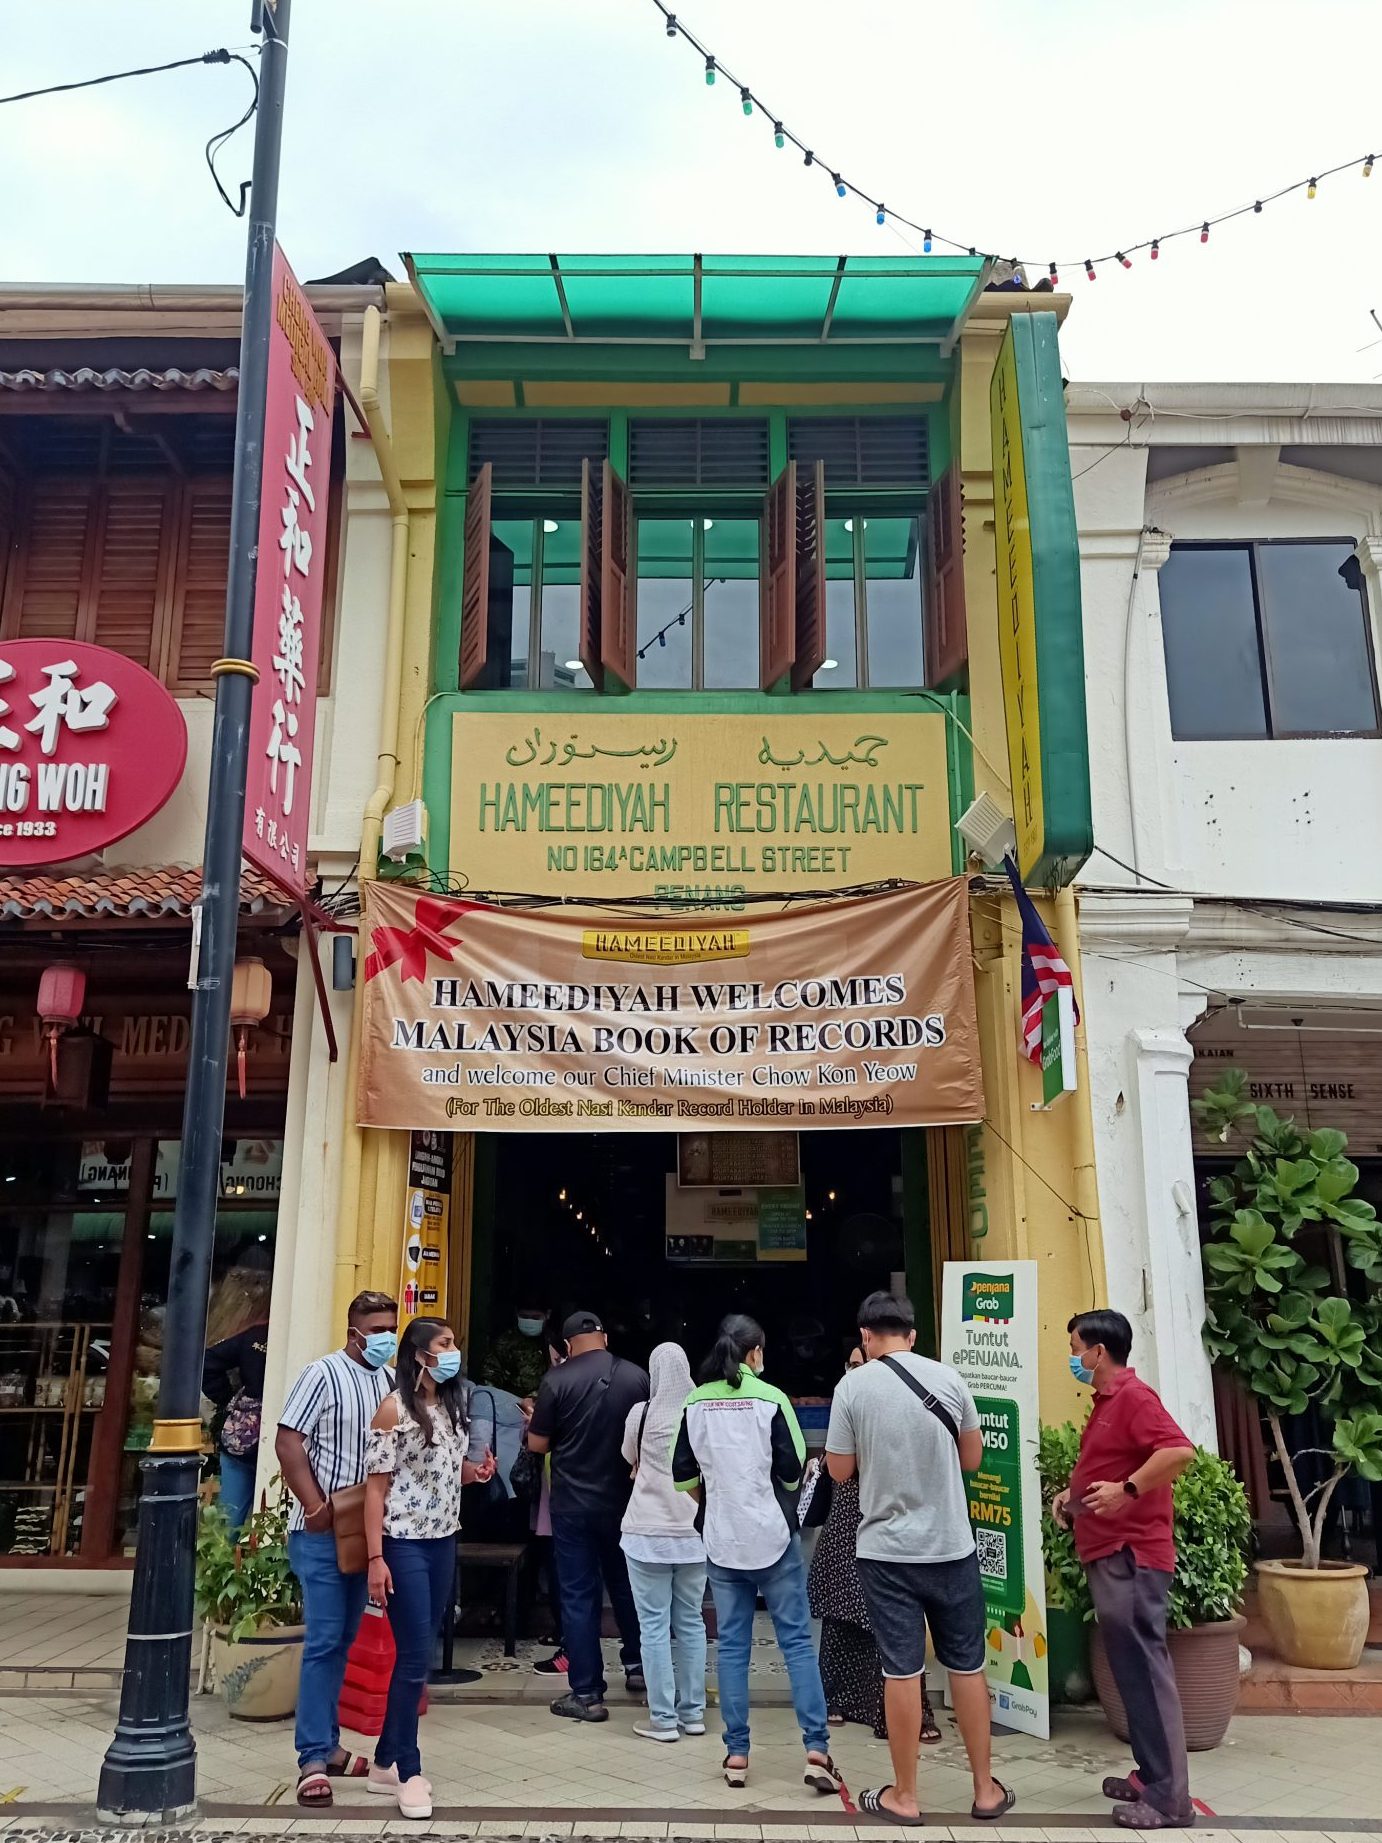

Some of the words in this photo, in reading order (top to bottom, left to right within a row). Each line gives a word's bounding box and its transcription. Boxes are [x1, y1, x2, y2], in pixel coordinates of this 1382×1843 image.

[999, 367, 1033, 829] HAMEEDIYAH
[37, 763, 111, 813] WOH
[479, 783, 670, 832] HAMEEDIYAH
[714, 783, 925, 833] RESTAURANT
[15, 821, 57, 837] 1933
[548, 845, 578, 872] NO
[629, 845, 756, 873] CAMPBELL
[761, 845, 852, 873] STREET
[654, 884, 746, 912] PENANG
[595, 933, 736, 952] HAMEEDIYAH
[432, 978, 683, 1013] HAMEEDIYAH
[689, 974, 905, 1012] WELCOMES
[392, 1018, 585, 1053] MALAYSIA
[591, 1025, 701, 1055] BOOK
[708, 1024, 759, 1054] OF
[766, 1015, 945, 1053] RECORDS
[423, 1064, 460, 1085] and
[468, 1065, 556, 1086] welcome
[563, 1069, 596, 1085] our
[604, 1066, 657, 1086] Chief
[663, 1068, 744, 1087] Minister
[752, 1066, 811, 1086] Chow
[818, 1065, 857, 1085] Kon
[863, 1062, 917, 1082] Yeow
[1250, 1083, 1294, 1099] SIXTH
[1310, 1083, 1356, 1099] SENSE
[445, 1097, 479, 1118] (For
[483, 1098, 516, 1116] The
[519, 1098, 573, 1117] Oldest
[577, 1098, 613, 1117] Nasi
[617, 1099, 674, 1117] Kandar
[678, 1099, 734, 1117] Record
[738, 1098, 794, 1116] Holder
[799, 1098, 815, 1115] In
[819, 1094, 894, 1119] Malaysia)
[977, 1282, 1010, 1295] penjana
[975, 1297, 999, 1310] Grab
[965, 1329, 1009, 1347] Tuntut
[952, 1349, 1023, 1369] ePENJANA.
[958, 1371, 981, 1379] apatkan
[967, 1381, 980, 1389] Grab
[980, 1382, 1008, 1391] PERCUMA!
[979, 1411, 1009, 1429] ntut
[981, 1430, 1008, 1450] M50
[970, 1500, 1012, 1526] RM75
[1011, 1700, 1038, 1719] GrabPay
